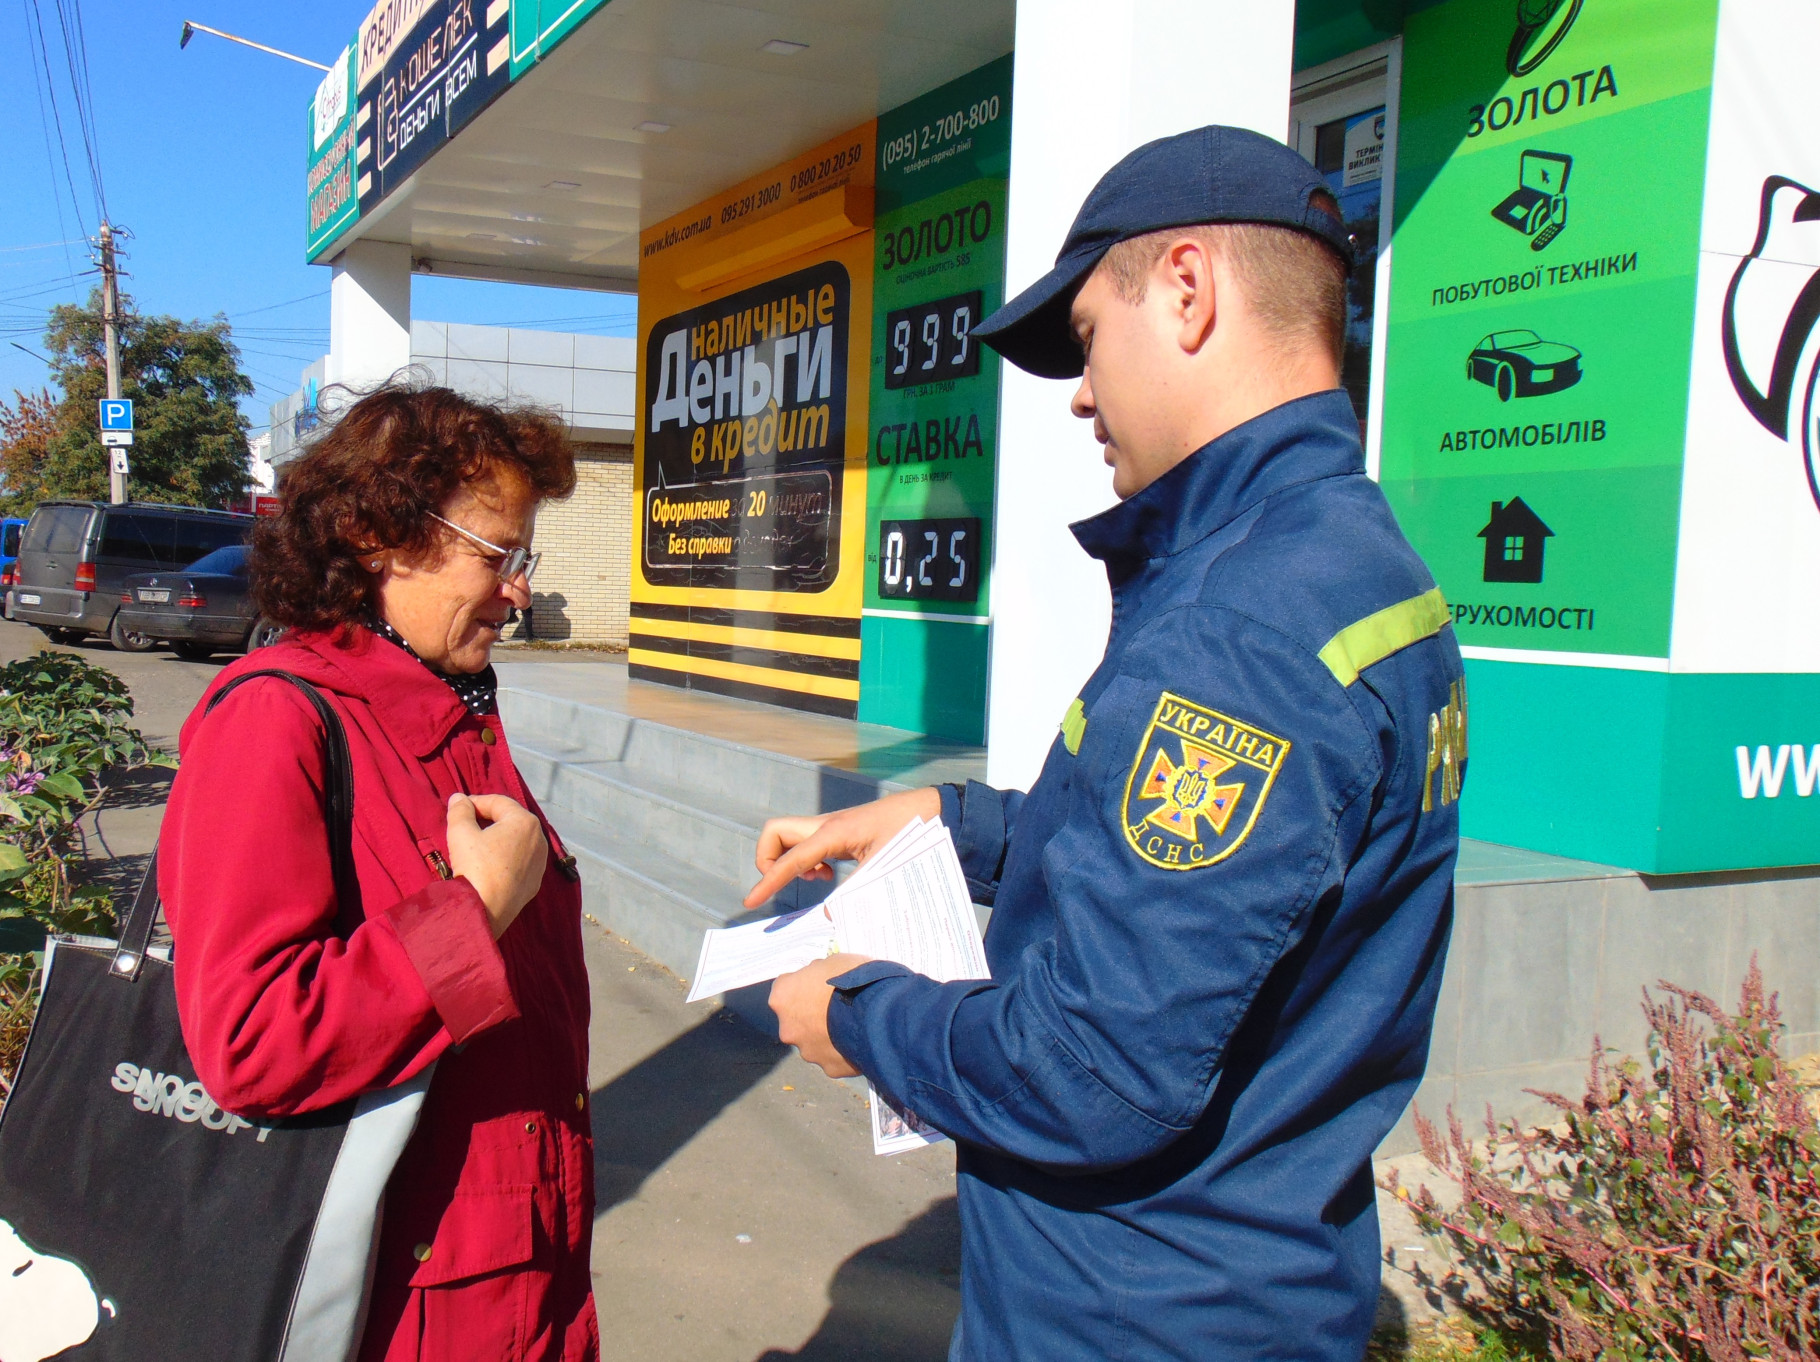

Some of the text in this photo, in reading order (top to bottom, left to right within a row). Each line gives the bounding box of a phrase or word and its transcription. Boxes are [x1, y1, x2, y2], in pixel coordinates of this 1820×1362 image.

[400, 0, 473, 102] КОШЕЛЕК
[400, 49, 477, 150] ДЕНЬГИ ВСЕМ
[1467, 64, 1618, 138] ЗОЛОТА
[882, 95, 1000, 171] (095) 2-700-800
[1356, 143, 1384, 158] ТЕРМІН
[798, 165, 816, 189] 800
[847, 144, 862, 166] 50
[311, 159, 351, 235] МАГАЗИН
[721, 182, 781, 224] 095 291 3000
[644, 215, 712, 258] www.kdv.com.ua
[883, 200, 992, 271] ЗОЛОТО
[1432, 252, 1639, 306] ПОБУТОВОЇ ТЕХНІКИ
[691, 282, 835, 361] наличные
[893, 306, 971, 375] 999
[651, 325, 833, 433] Деньги
[107, 403, 125, 426] P
[691, 397, 830, 474] в кредит
[876, 413, 983, 465] СТАВКА
[1440, 419, 1607, 452] АВТОМОБІЛІВ
[652, 497, 731, 528] Оформление
[747, 490, 766, 517] 20
[668, 533, 687, 555] Без
[688, 536, 732, 560] справки
[884, 531, 966, 594] 0,25
[1446, 603, 1595, 631] РУХОМОСТІ
[1160, 702, 1274, 766] УКРАЇНА
[1128, 818, 1206, 863] ДСНС
[111, 1062, 210, 1109] SNOO
